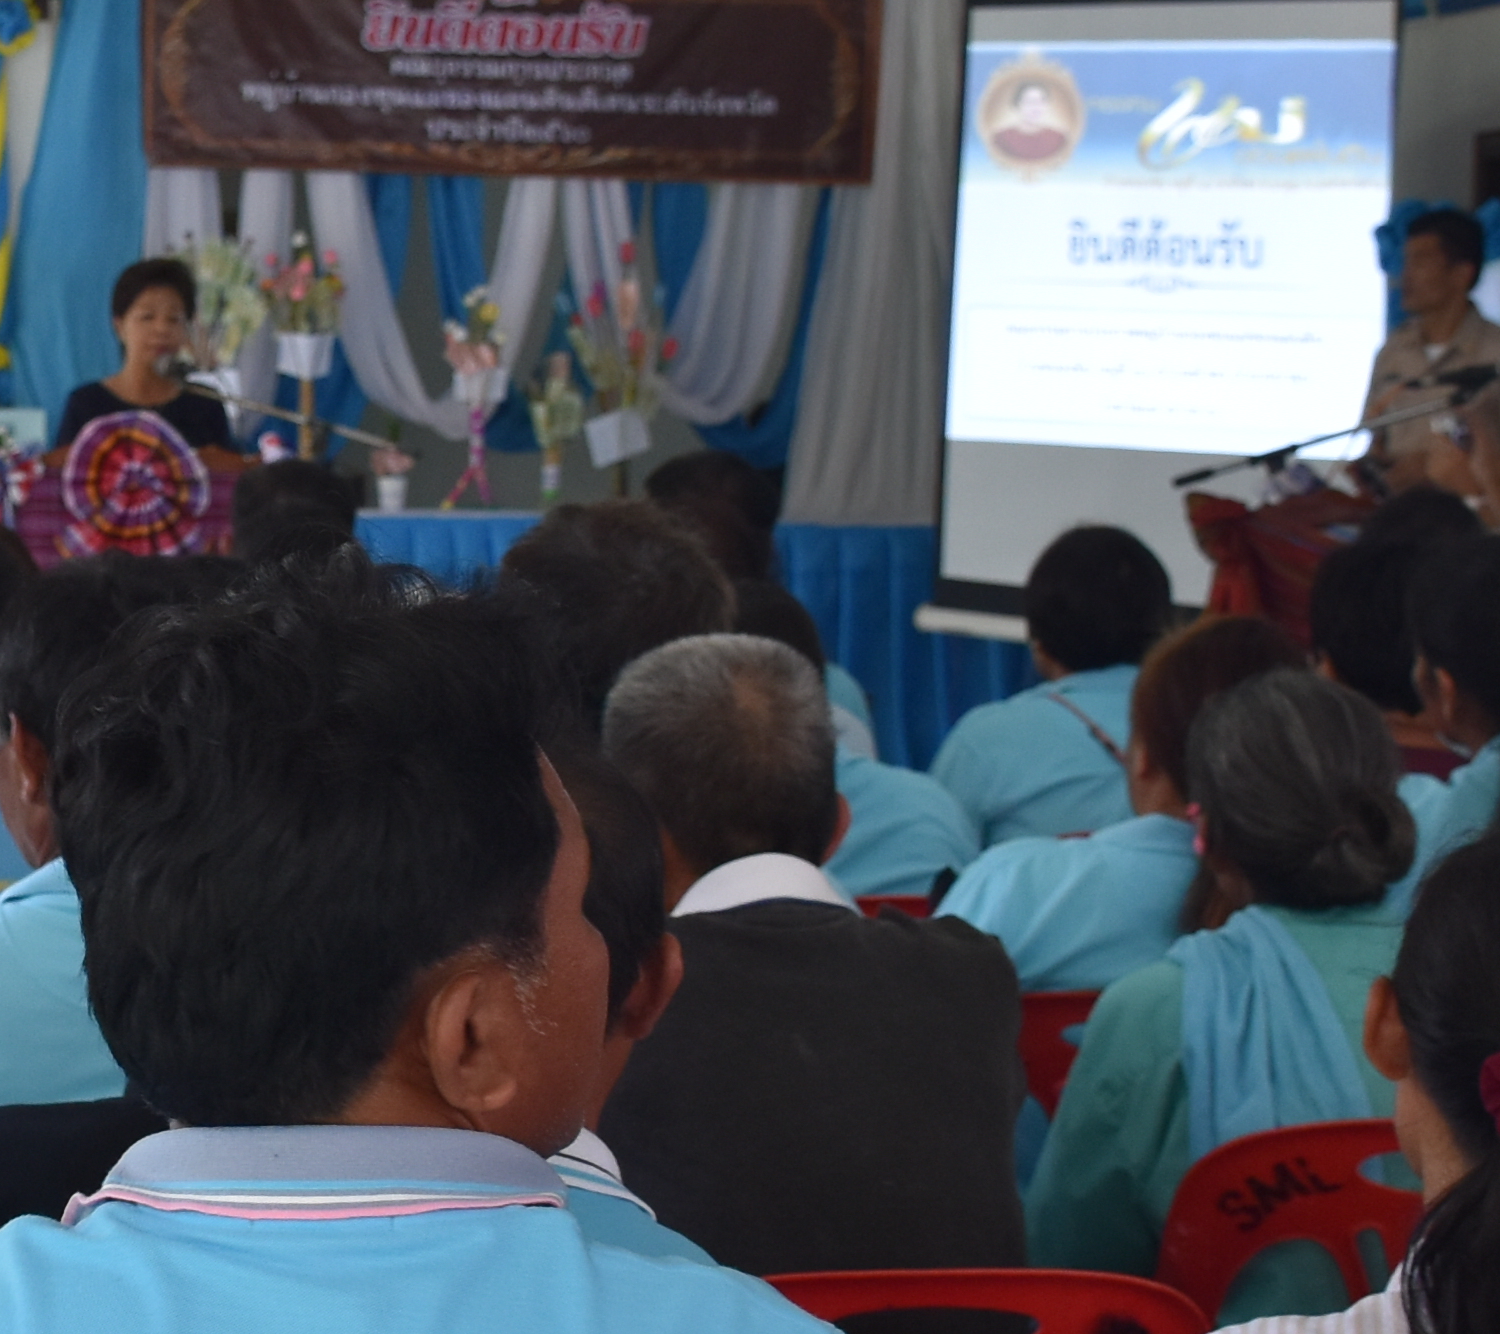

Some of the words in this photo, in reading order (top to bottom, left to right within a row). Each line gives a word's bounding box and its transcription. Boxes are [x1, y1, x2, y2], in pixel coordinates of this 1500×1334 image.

[1067, 219, 1264, 269] ยินดีต้อนรับ
[1215, 1156, 1344, 1232] SML
